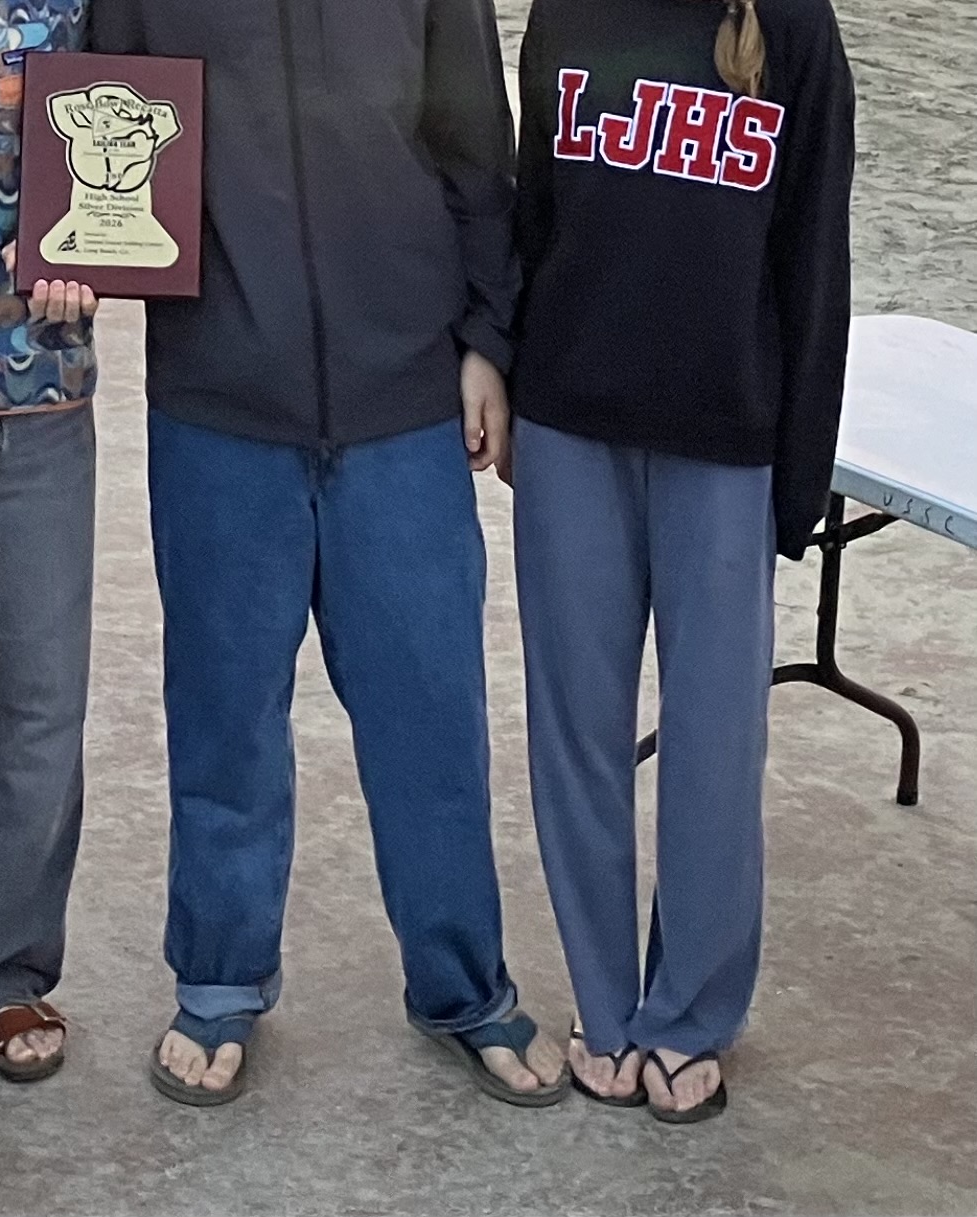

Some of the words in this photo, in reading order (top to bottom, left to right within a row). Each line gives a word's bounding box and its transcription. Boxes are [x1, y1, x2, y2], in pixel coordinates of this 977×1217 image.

[554, 68, 785, 191] LJHS
[85, 192, 108, 202] High
[110, 193, 139, 202] School
[78, 203, 104, 211] Silver
[106, 204, 144, 213] Division
